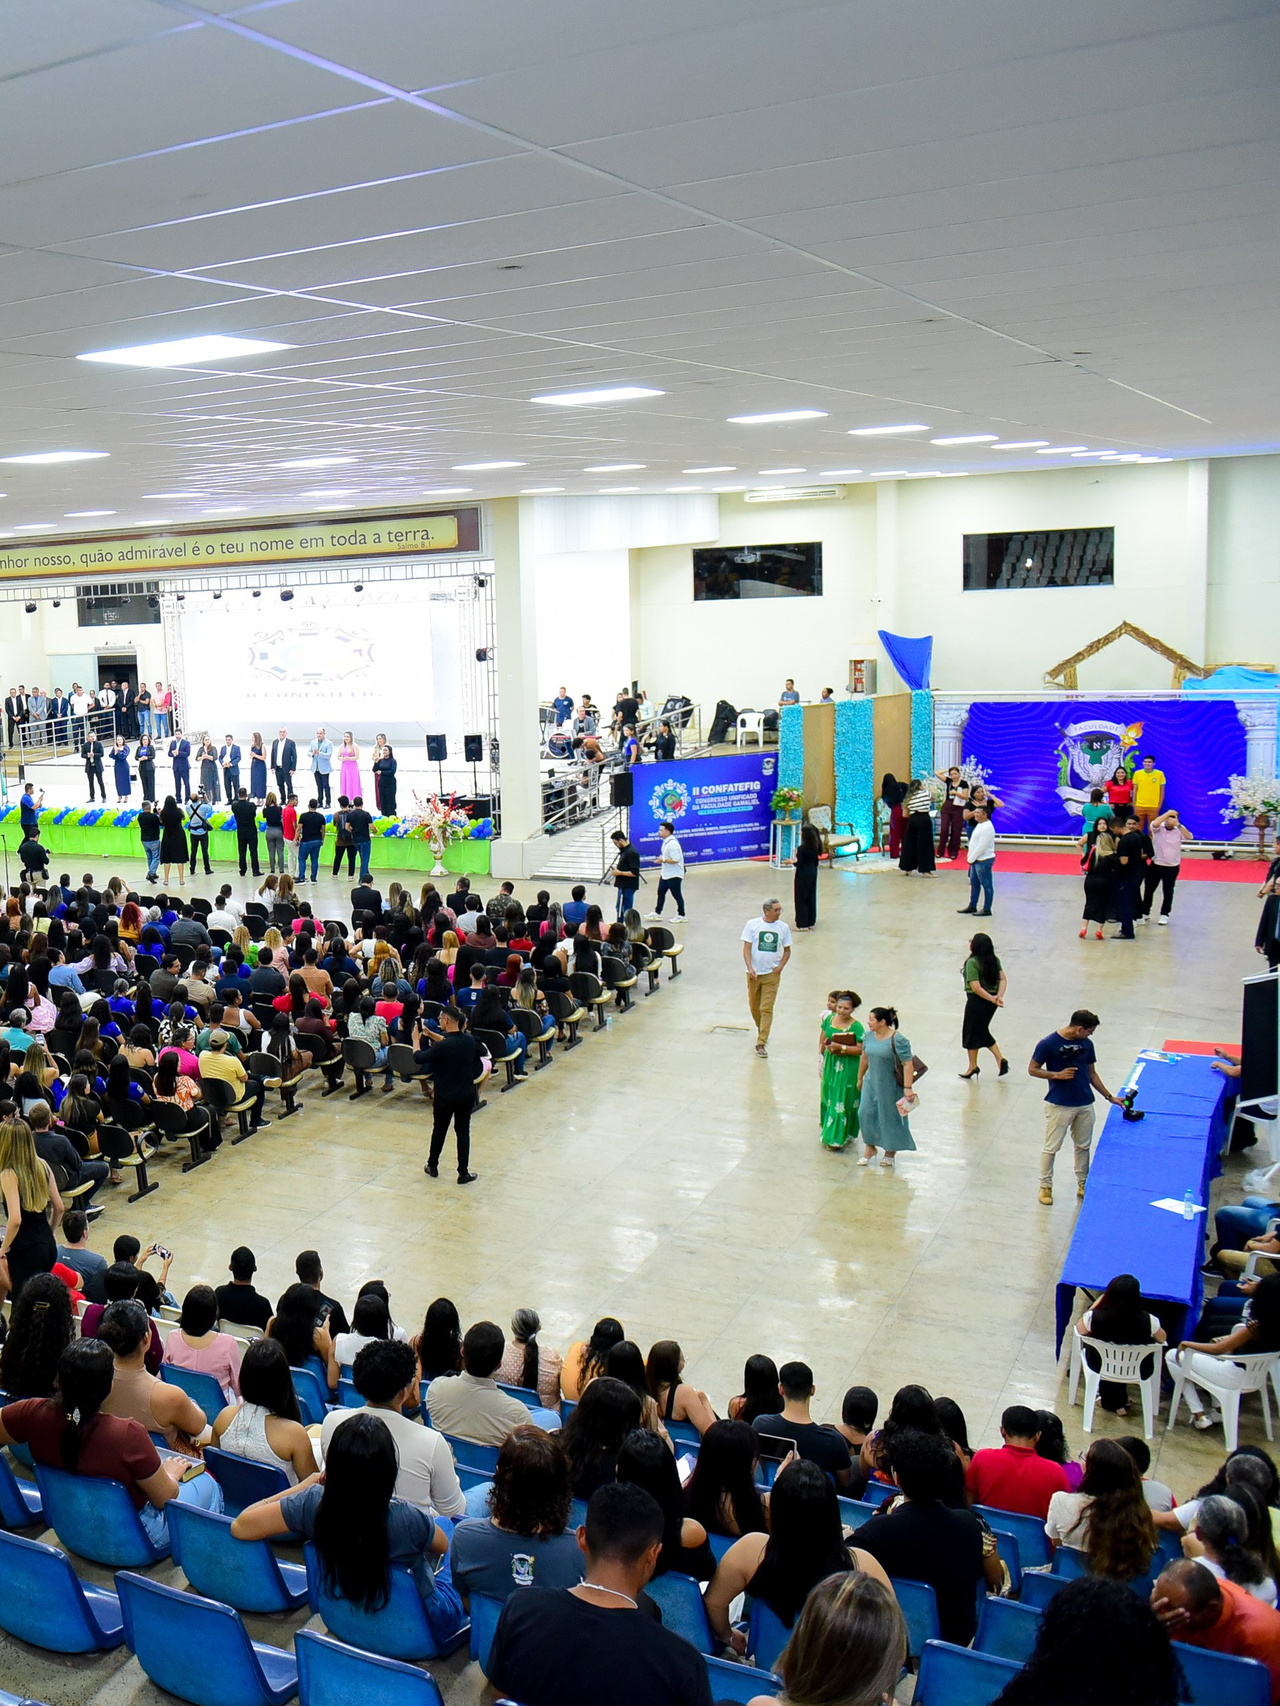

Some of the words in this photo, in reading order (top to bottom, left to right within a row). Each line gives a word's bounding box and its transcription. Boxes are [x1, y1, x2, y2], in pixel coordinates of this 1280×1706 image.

[34, 555, 75, 568] nosso,
[80, 548, 114, 567] quão
[118, 542, 186, 561] admirável
[191, 540, 200, 555] é
[205, 544, 215, 555] o
[220, 540, 244, 553] teu
[250, 538, 294, 552] nome
[300, 536, 324, 549] em
[330, 529, 367, 546] toda
[373, 532, 382, 543] a
[388, 528, 435, 542] terra.
[397, 542, 419, 550] Salmo
[1074, 724, 1119, 732] FACULDADE
[692, 786, 700, 796] II
[701, 781, 760, 794] CONFATEFIG
[695, 795, 728, 804] CONGRESSO
